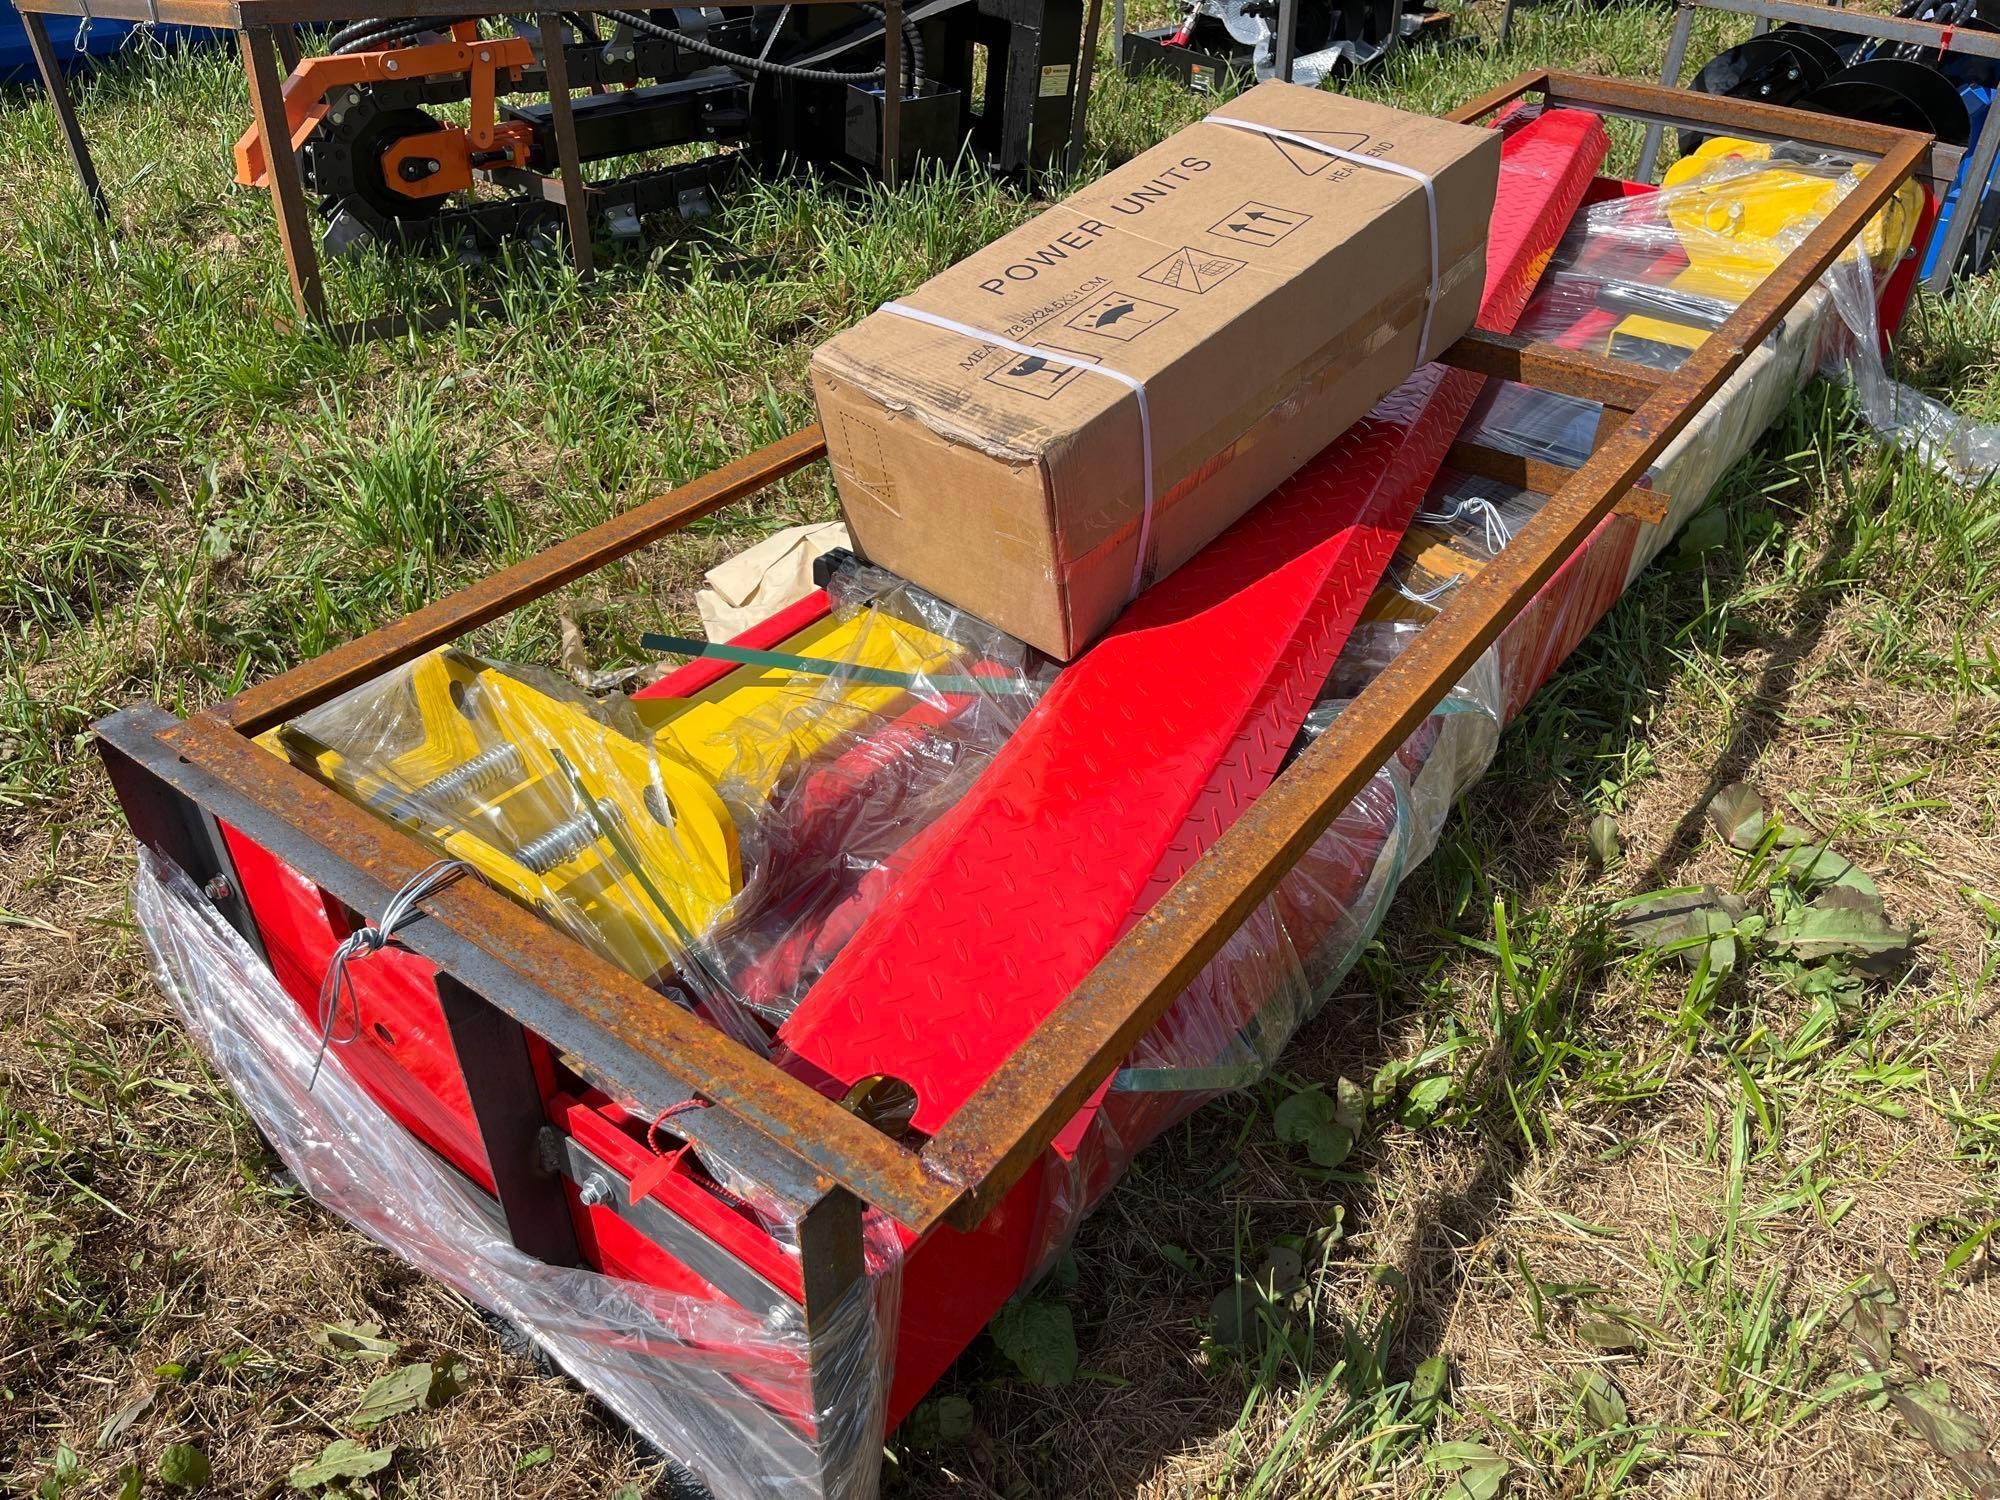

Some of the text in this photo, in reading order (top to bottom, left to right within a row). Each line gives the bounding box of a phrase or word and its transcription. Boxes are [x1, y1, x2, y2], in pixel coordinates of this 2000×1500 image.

[1364, 141, 1395, 158] END
[978, 157, 1212, 296] POWER UNITS
